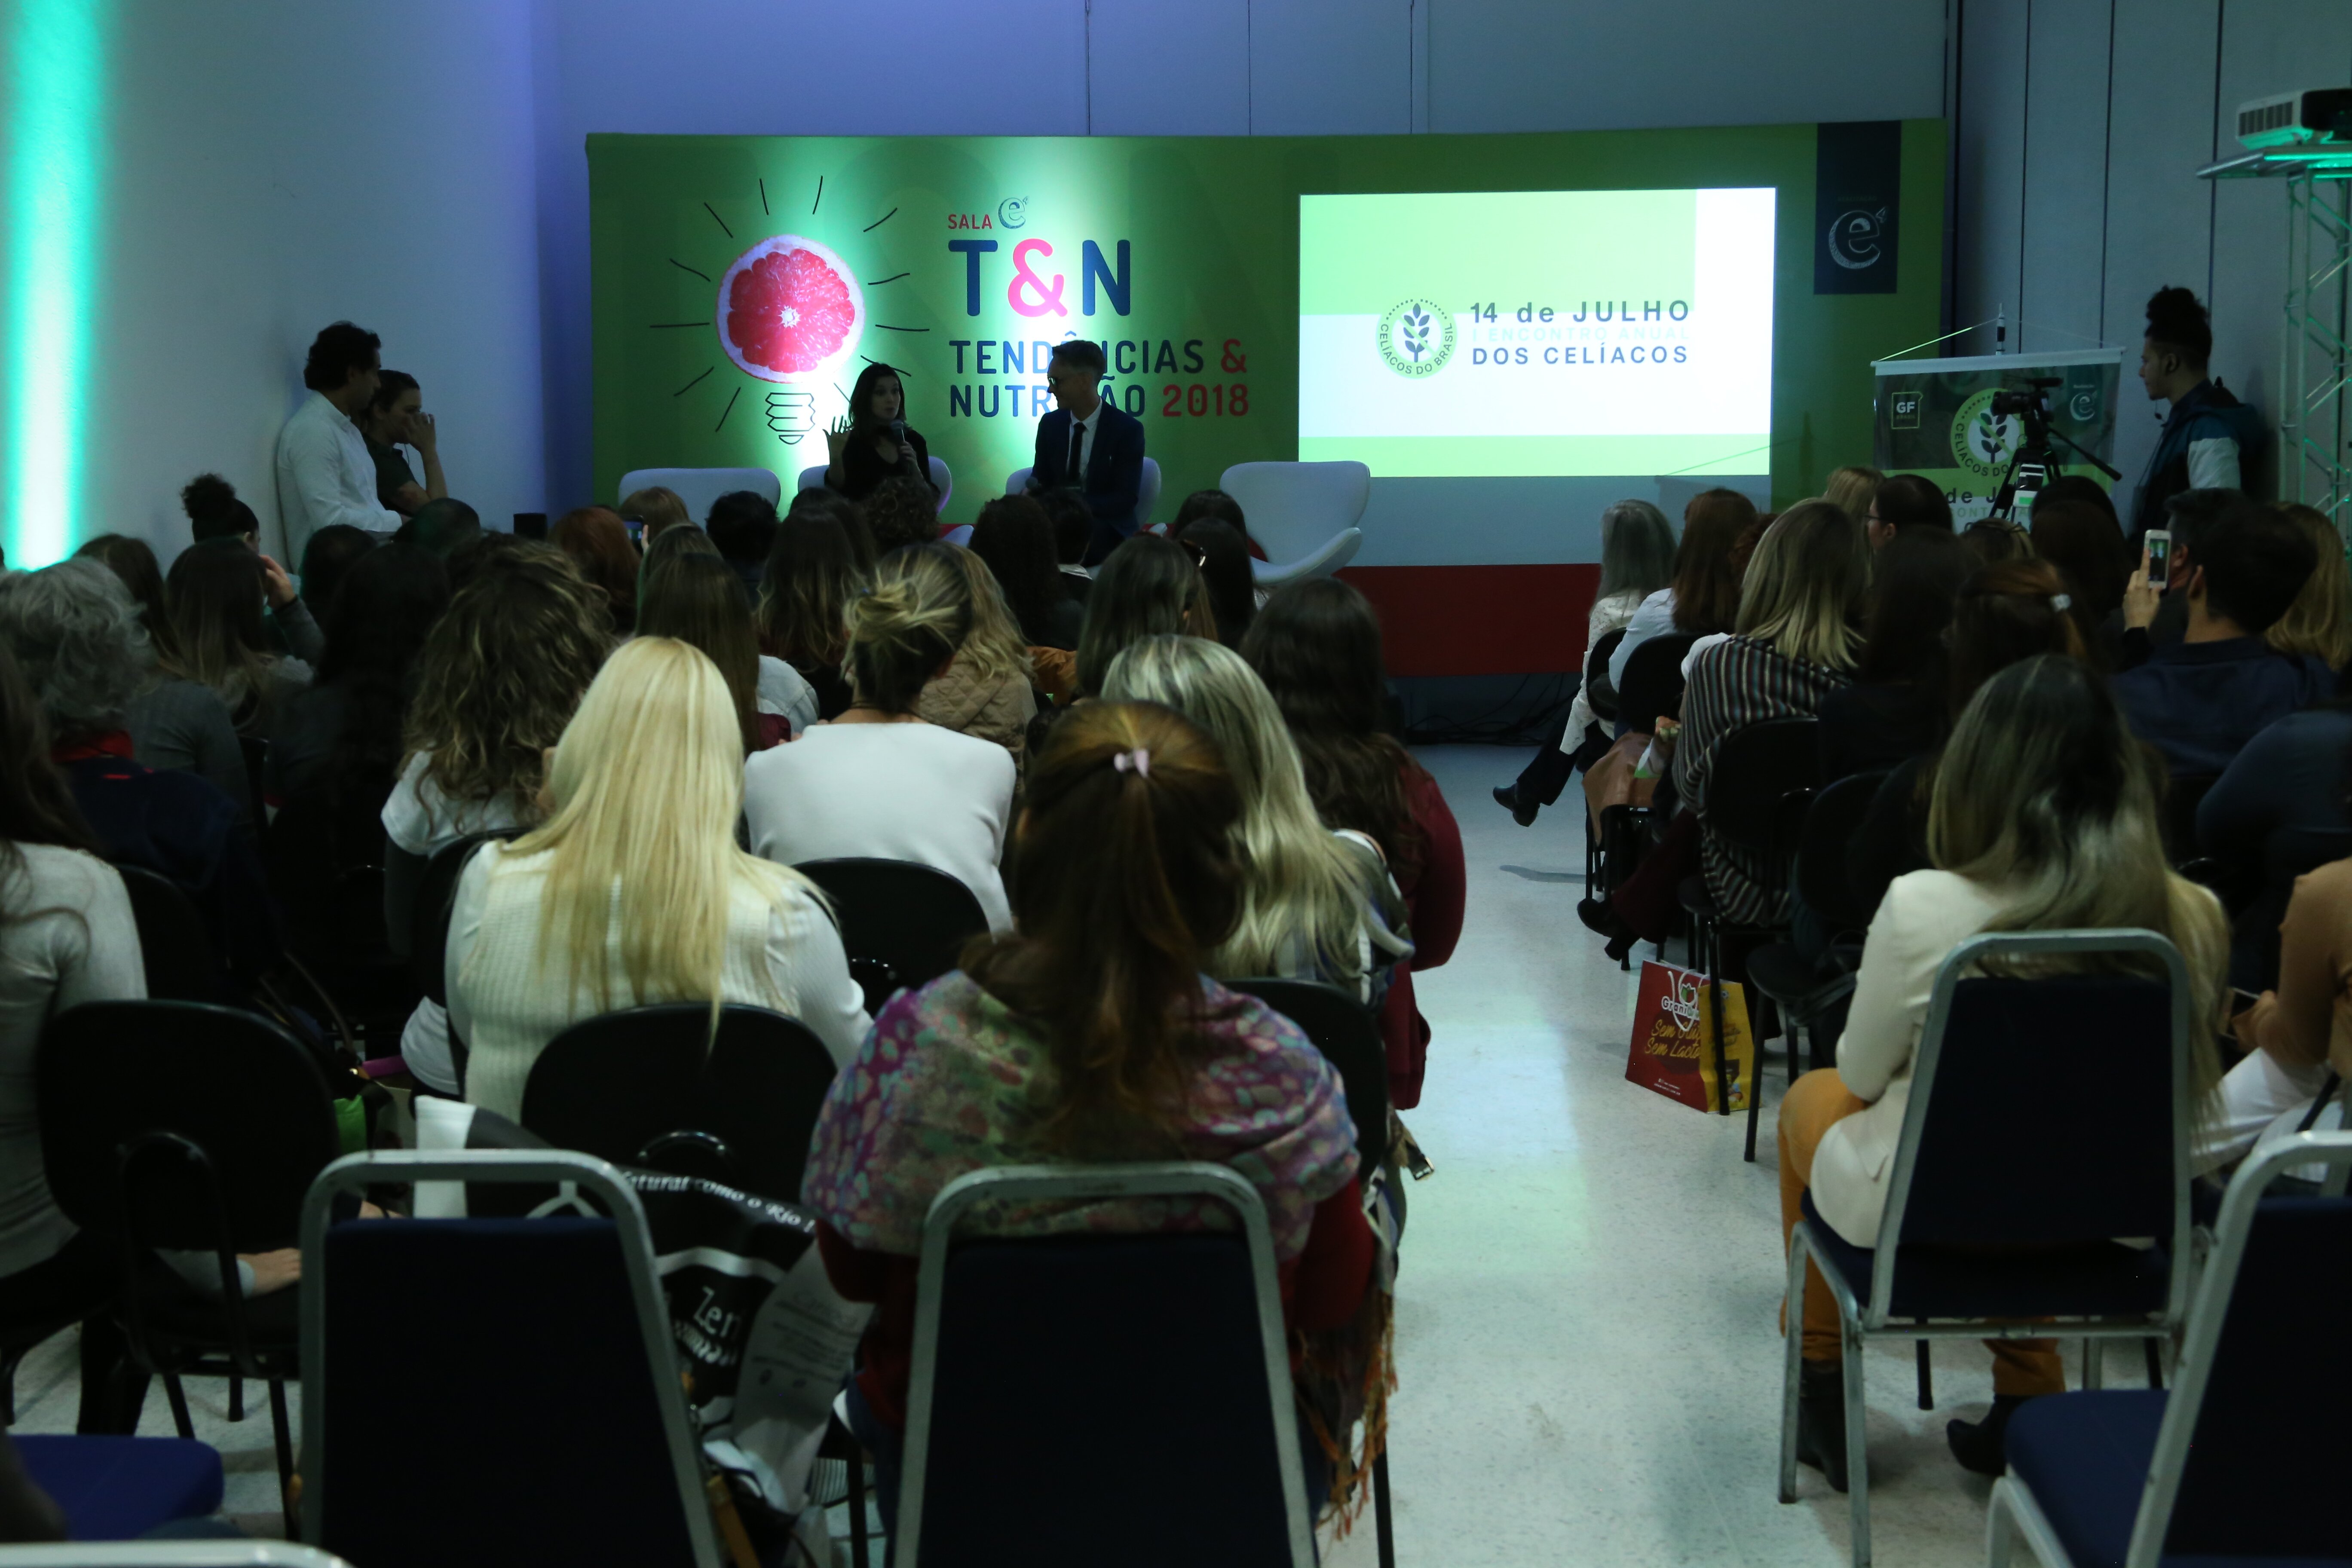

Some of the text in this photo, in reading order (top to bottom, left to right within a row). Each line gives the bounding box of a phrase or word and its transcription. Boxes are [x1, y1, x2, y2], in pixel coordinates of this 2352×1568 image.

[948, 214, 992, 230] SALA
[948, 238, 1131, 317] T&N
[1470, 300, 1688, 323] 14 de JULHO
[1488, 327, 1607, 342] ENCONTRO
[1619, 326, 1689, 340] ANUAL
[949, 331, 1248, 374] TENDCIAS &
[1380, 323, 1453, 375] CELÍACOS DO BRASIL
[1473, 342, 1687, 365] DOS CELÍACOS
[950, 375, 1249, 417] NUTRÃO 2018
[1896, 401, 1916, 413] GF
[1993, 464, 2009, 477] DO
[1946, 487, 1973, 504] de
[1651, 1019, 1676, 1038] Sem
[1644, 1037, 1668, 1056] Sem
